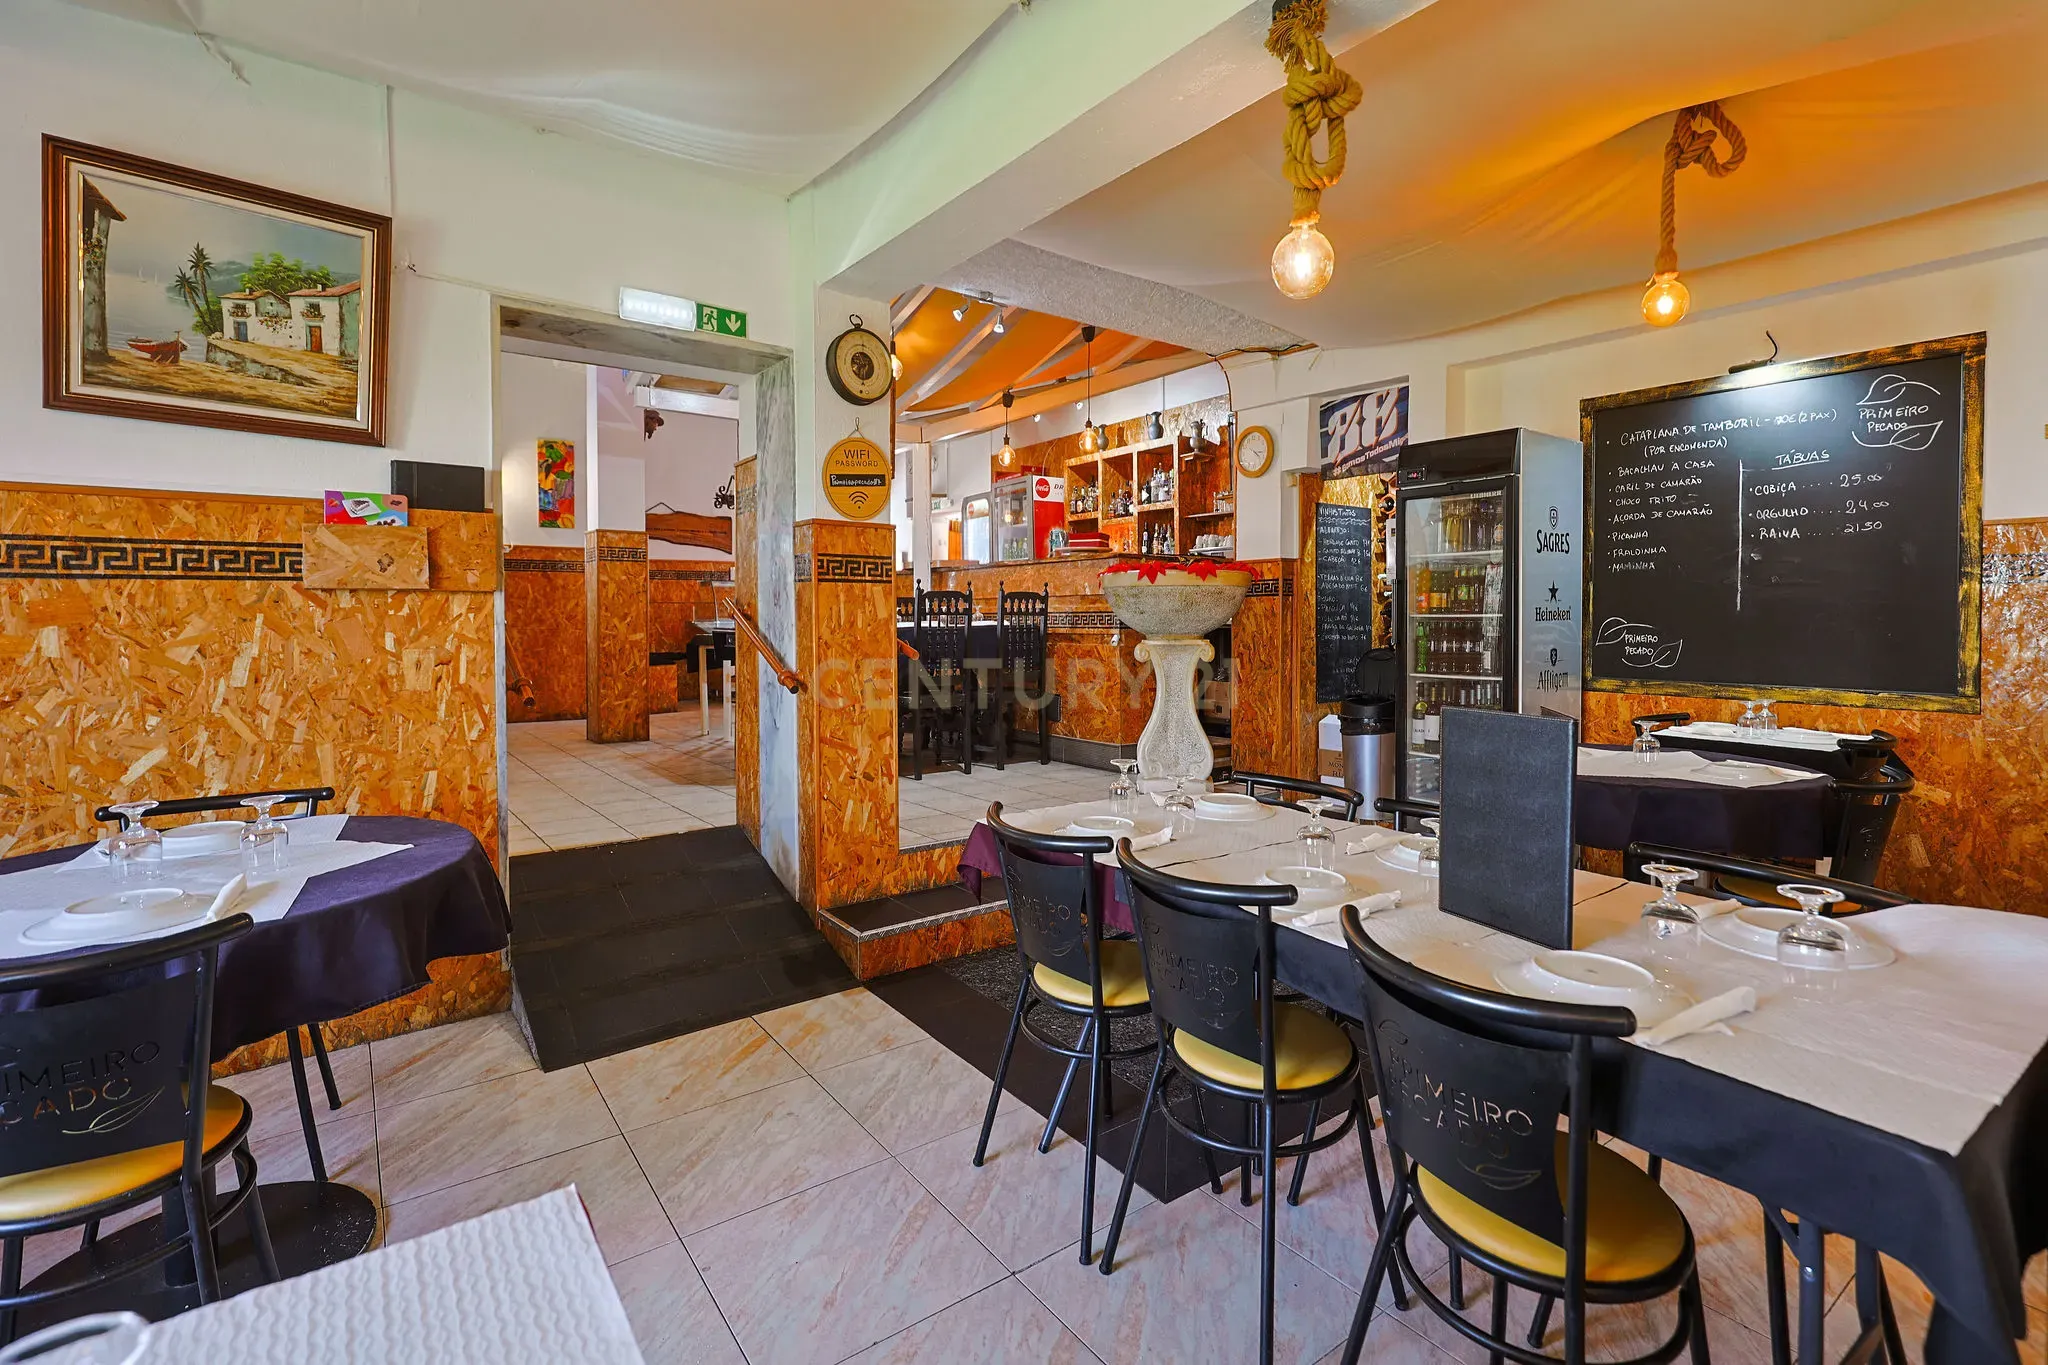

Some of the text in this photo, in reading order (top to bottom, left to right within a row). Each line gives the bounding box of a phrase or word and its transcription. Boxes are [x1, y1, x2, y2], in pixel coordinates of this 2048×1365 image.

[1859, 404, 1929, 420] PRIMEIRO
[1620, 426, 1679, 446] CATAPLANA
[1683, 425, 1697, 435] DE
[1701, 415, 1761, 432] TAMBORIL
[1867, 421, 1908, 433] PECADO
[843, 449, 870, 460] WIFI
[1775, 449, 1830, 466] TÁBUAS
[1617, 463, 1665, 477] BACALHAU
[1684, 459, 1715, 469] CASA
[1614, 475, 1703, 493] CARIL DE CAMARÃO
[1754, 481, 1796, 497] COBIÇA
[1615, 494, 1677, 507] CHOCO FRITO
[1650, 511, 1663, 519] DE
[1666, 503, 1713, 518] CAMARÃO
[1756, 506, 1809, 520] ORGULHO
[1611, 530, 1648, 541] PICANHA
[1759, 527, 1801, 540] RAIVA
[1536, 529, 1570, 555] SAGRES
[1612, 546, 1667, 558] FRALDINHA
[1612, 561, 1655, 573] MAMINHA
[1535, 606, 1571, 622] Heineken
[1624, 633, 1659, 643] PRIMEIRO
[1624, 646, 1654, 656] PECADO
[1537, 670, 1569, 693] Affligem
[0, 1041, 160, 1096] IMEIRO
[0, 1077, 132, 1125] CADO
